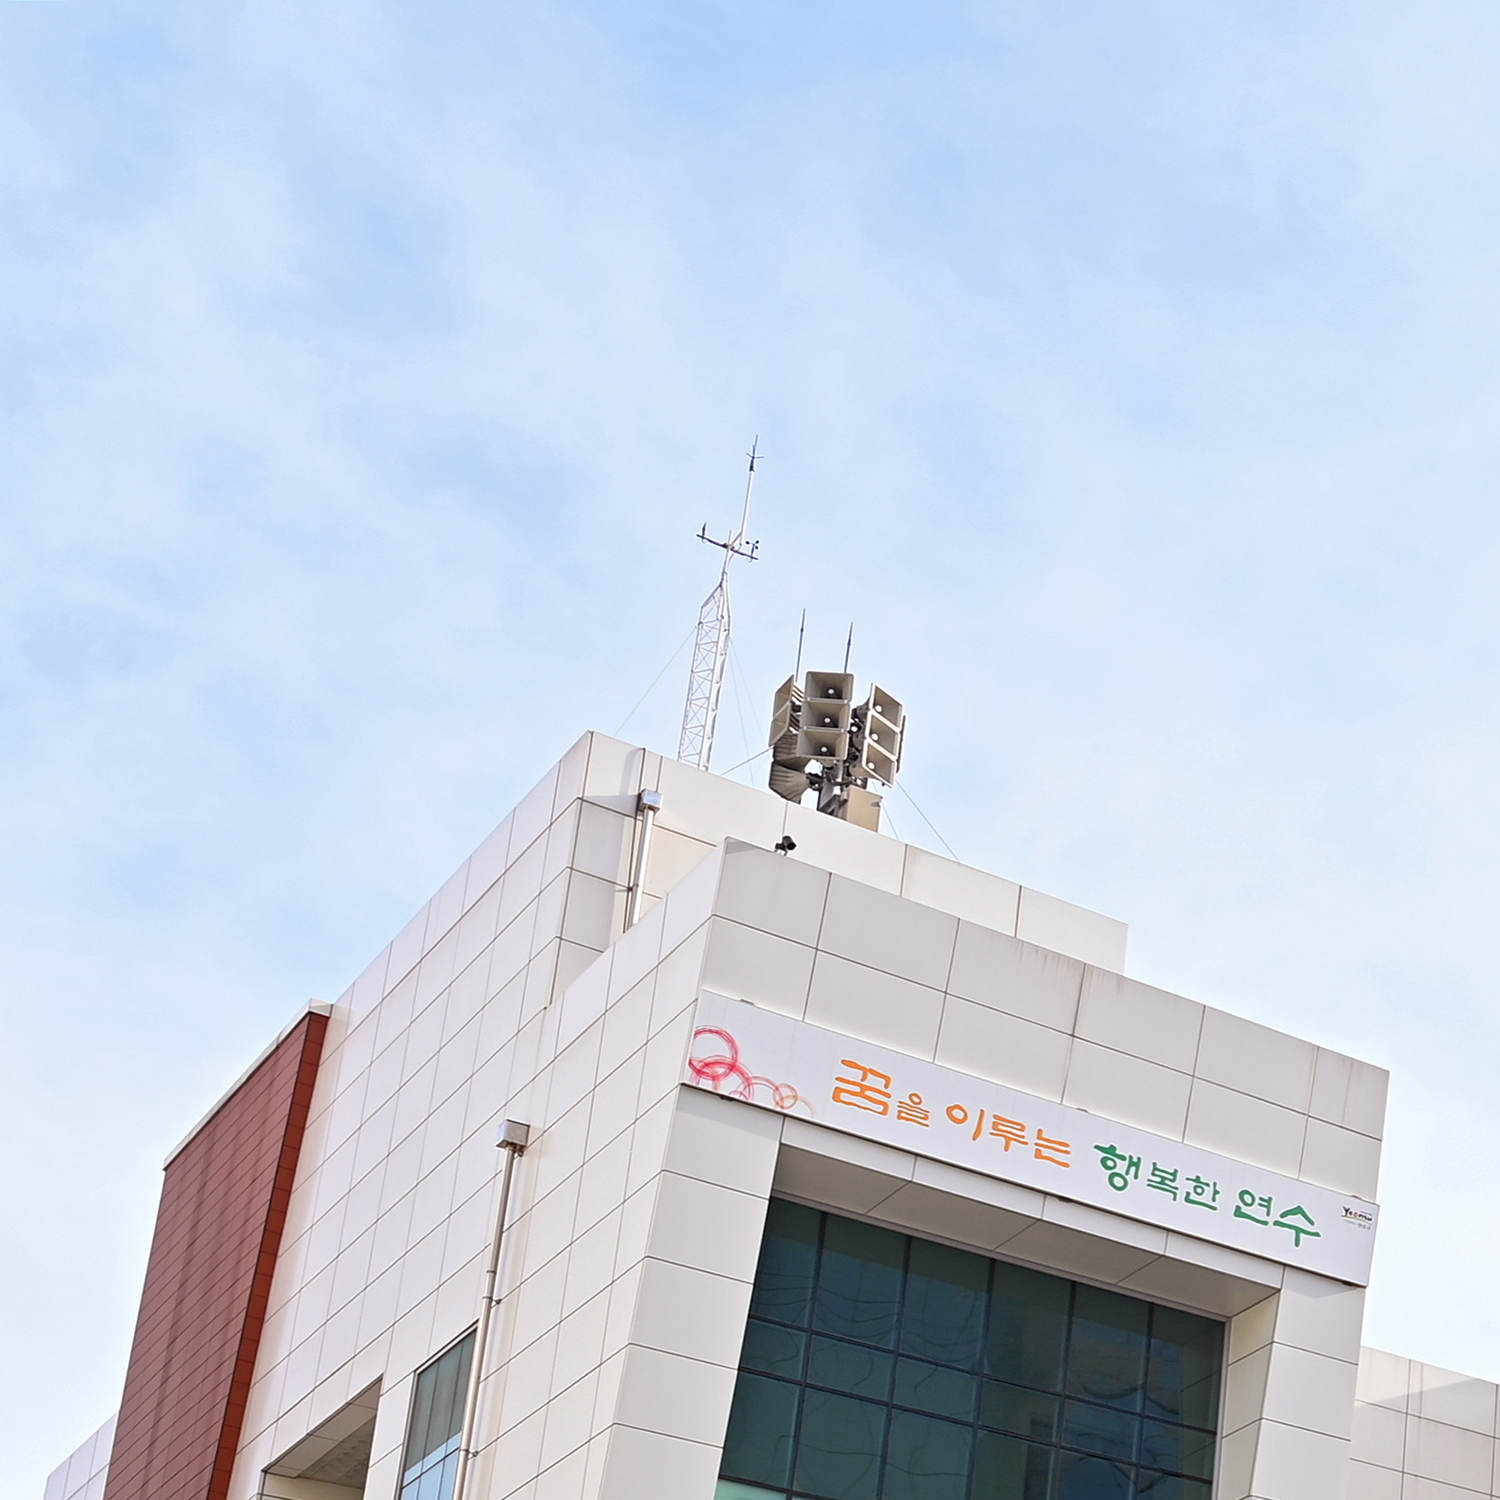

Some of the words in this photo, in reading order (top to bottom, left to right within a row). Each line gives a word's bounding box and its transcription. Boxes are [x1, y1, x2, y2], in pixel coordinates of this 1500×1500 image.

[832, 1059, 931, 1127] 꿈을
[946, 1104, 1071, 1168] 이루는
[1094, 1144, 1221, 1211] 행복한
[1233, 1189, 1321, 1247] 연수
